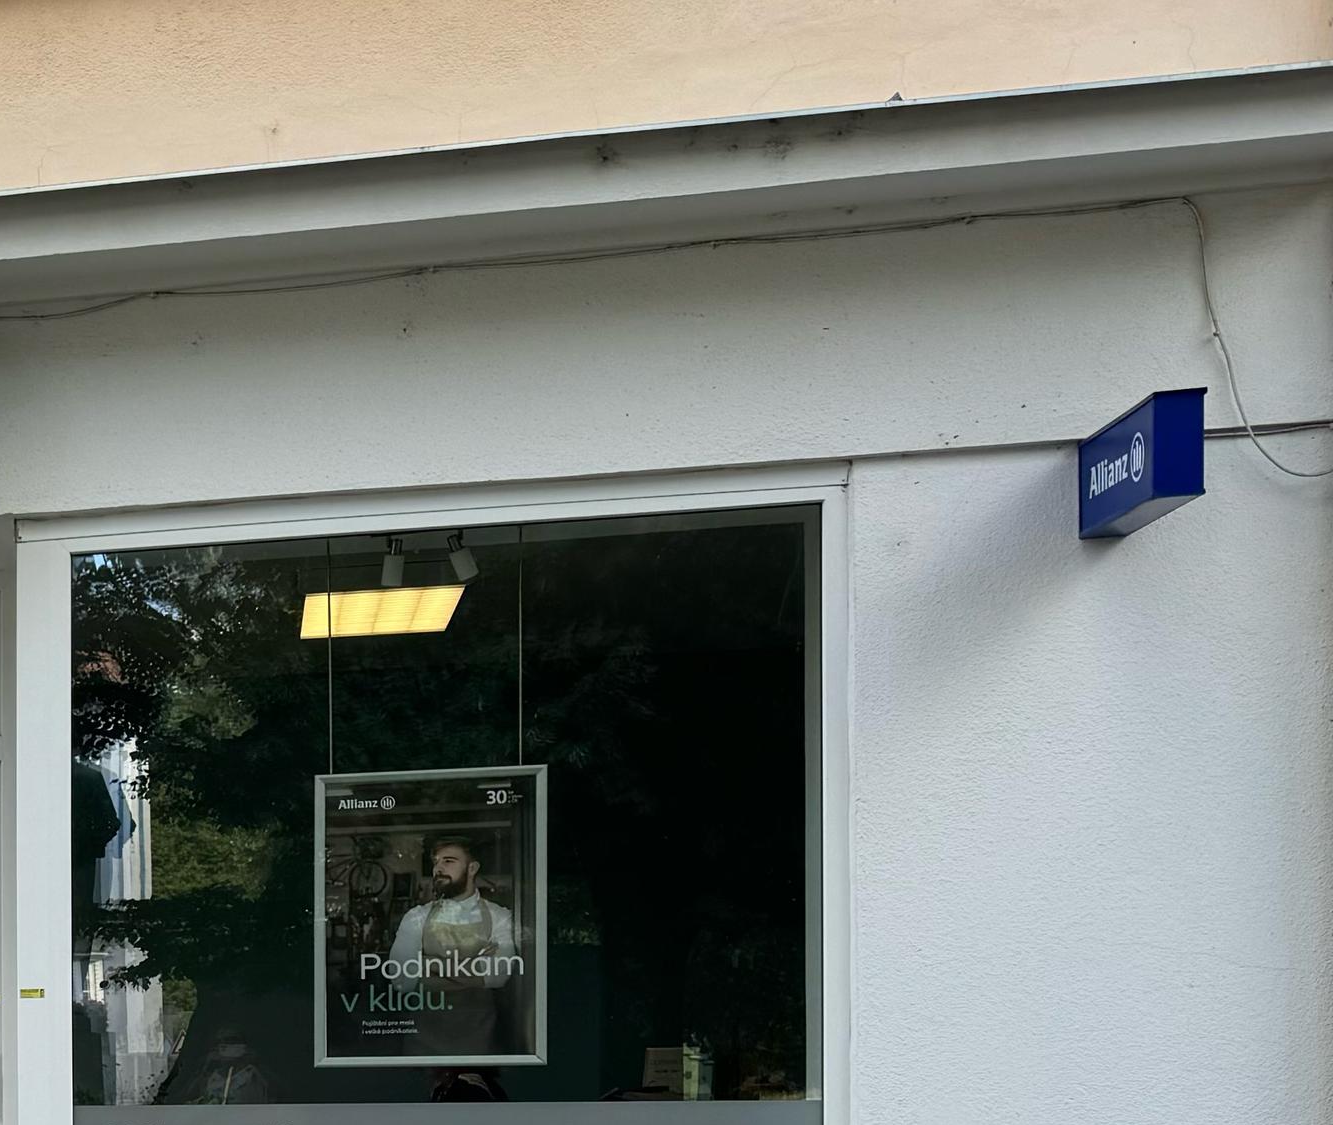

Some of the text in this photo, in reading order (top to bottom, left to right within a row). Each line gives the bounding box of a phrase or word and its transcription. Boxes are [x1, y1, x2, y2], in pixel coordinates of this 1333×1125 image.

[1089, 453, 1128, 499] Allianz
[338, 799, 378, 810] Allianz
[486, 790, 507, 805] 30
[360, 948, 524, 980] Podnikám
[341, 984, 453, 1013] v klidu.
